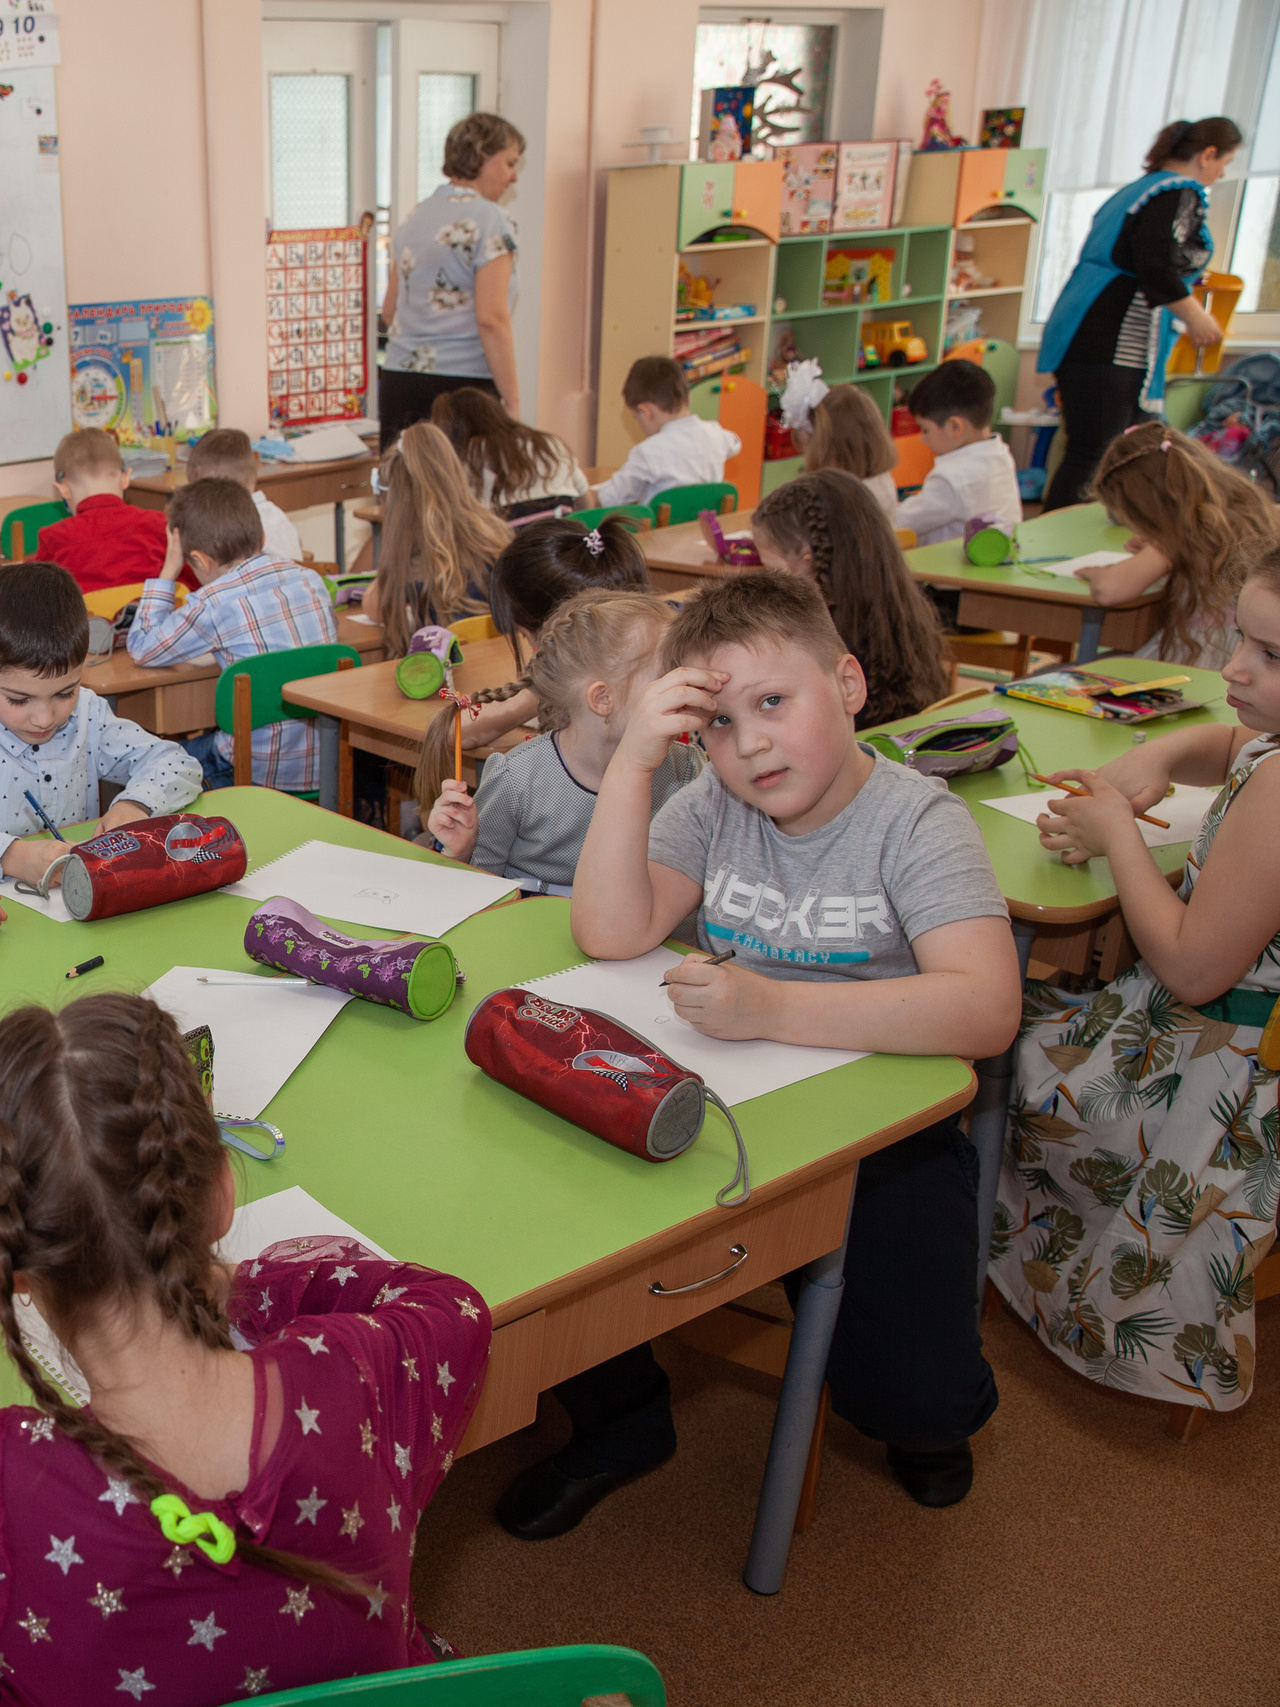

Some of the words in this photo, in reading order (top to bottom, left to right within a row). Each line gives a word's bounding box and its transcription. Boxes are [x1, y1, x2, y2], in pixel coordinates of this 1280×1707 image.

[13, 16, 35, 35] 10
[111, 838, 136, 854] kids
[169, 825, 226, 850] POWER
[529, 997, 577, 1022] POLAR
[539, 1014, 567, 1030] kids
